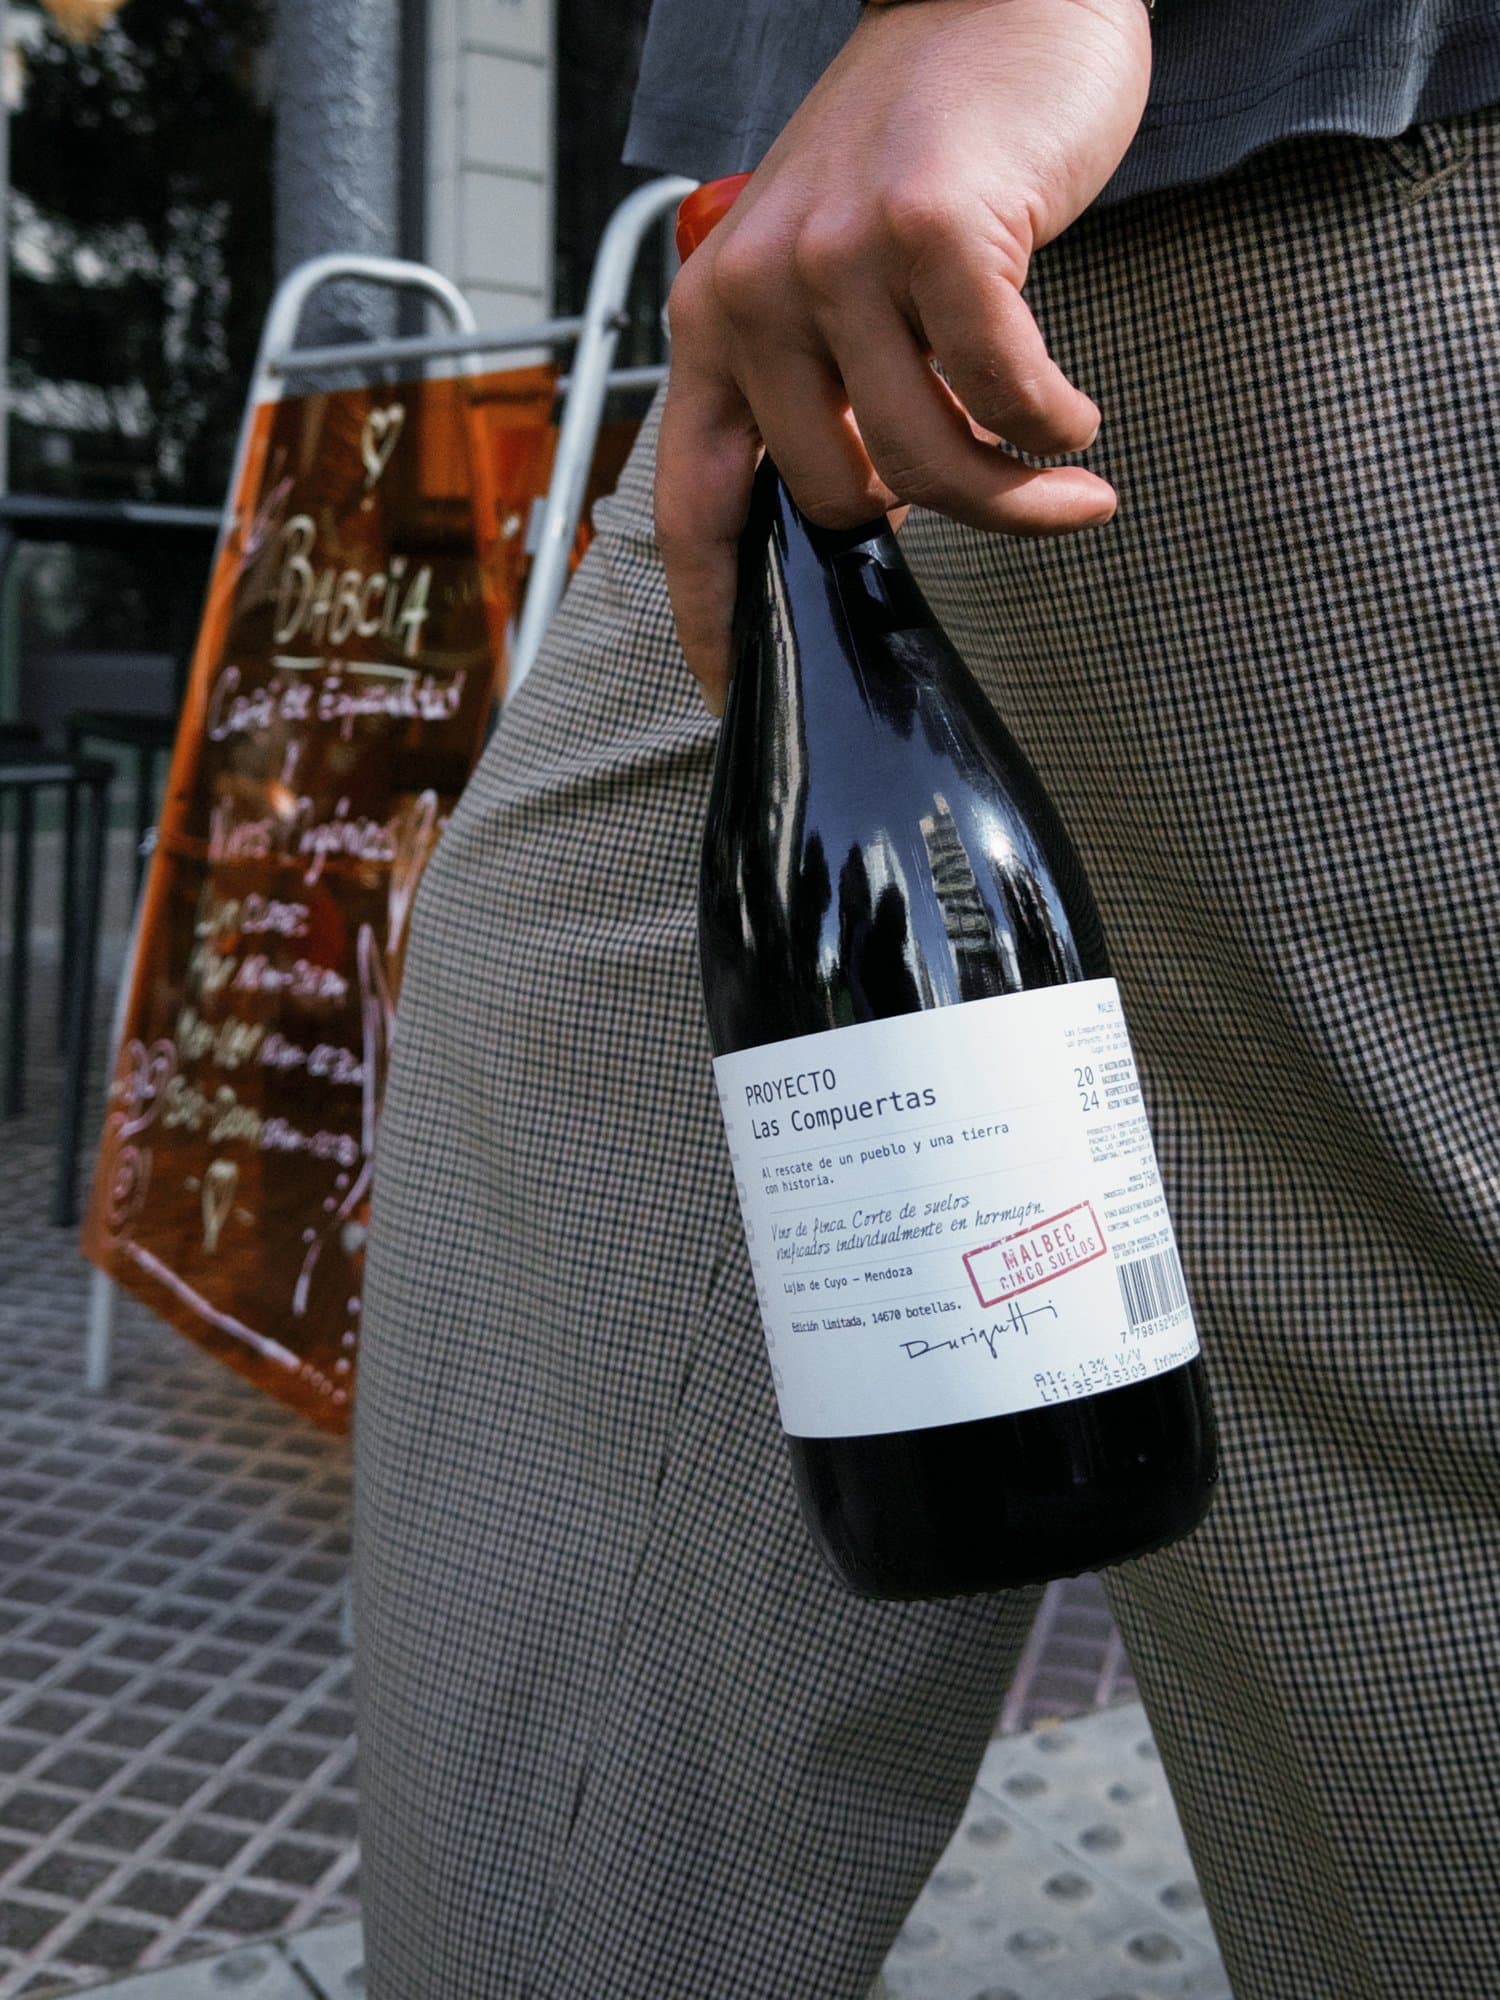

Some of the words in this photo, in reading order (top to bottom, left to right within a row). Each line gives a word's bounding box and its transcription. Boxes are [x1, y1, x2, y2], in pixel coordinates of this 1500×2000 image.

[745, 1069, 836, 1107] PROYECTO
[1074, 1066, 1094, 1087] 20
[752, 1118, 780, 1140] Las
[791, 1088, 937, 1132] Compuertas
[1079, 1090, 1099, 1112] 24
[762, 1165, 771, 1179] Al
[775, 1160, 813, 1177] rescate
[819, 1156, 833, 1169] de
[839, 1154, 854, 1167] un
[860, 1143, 906, 1165] pueblo
[913, 1140, 922, 1154] y
[930, 1134, 954, 1149] una
[962, 1122, 1009, 1142] tierra
[765, 1183, 779, 1195] con
[782, 1174, 835, 1192] historia.
[796, 1221, 808, 1237] de
[852, 1209, 892, 1229] Corte
[900, 1202, 916, 1220] de
[924, 1194, 970, 1216] suelos
[836, 1220, 943, 1253] individualmente
[951, 1218, 968, 1232] en
[1002, 1223, 1075, 1271] MALBEC
[810, 1279, 820, 1291] de
[824, 1277, 847, 1291] Cuyo
[864, 1266, 913, 1282] Mendoza
[1000, 1262, 1044, 1290] CINCO
[1049, 1237, 1096, 1270] SUELOS
[872, 1309, 900, 1324] 14670
[906, 1301, 961, 1319] botellas.
